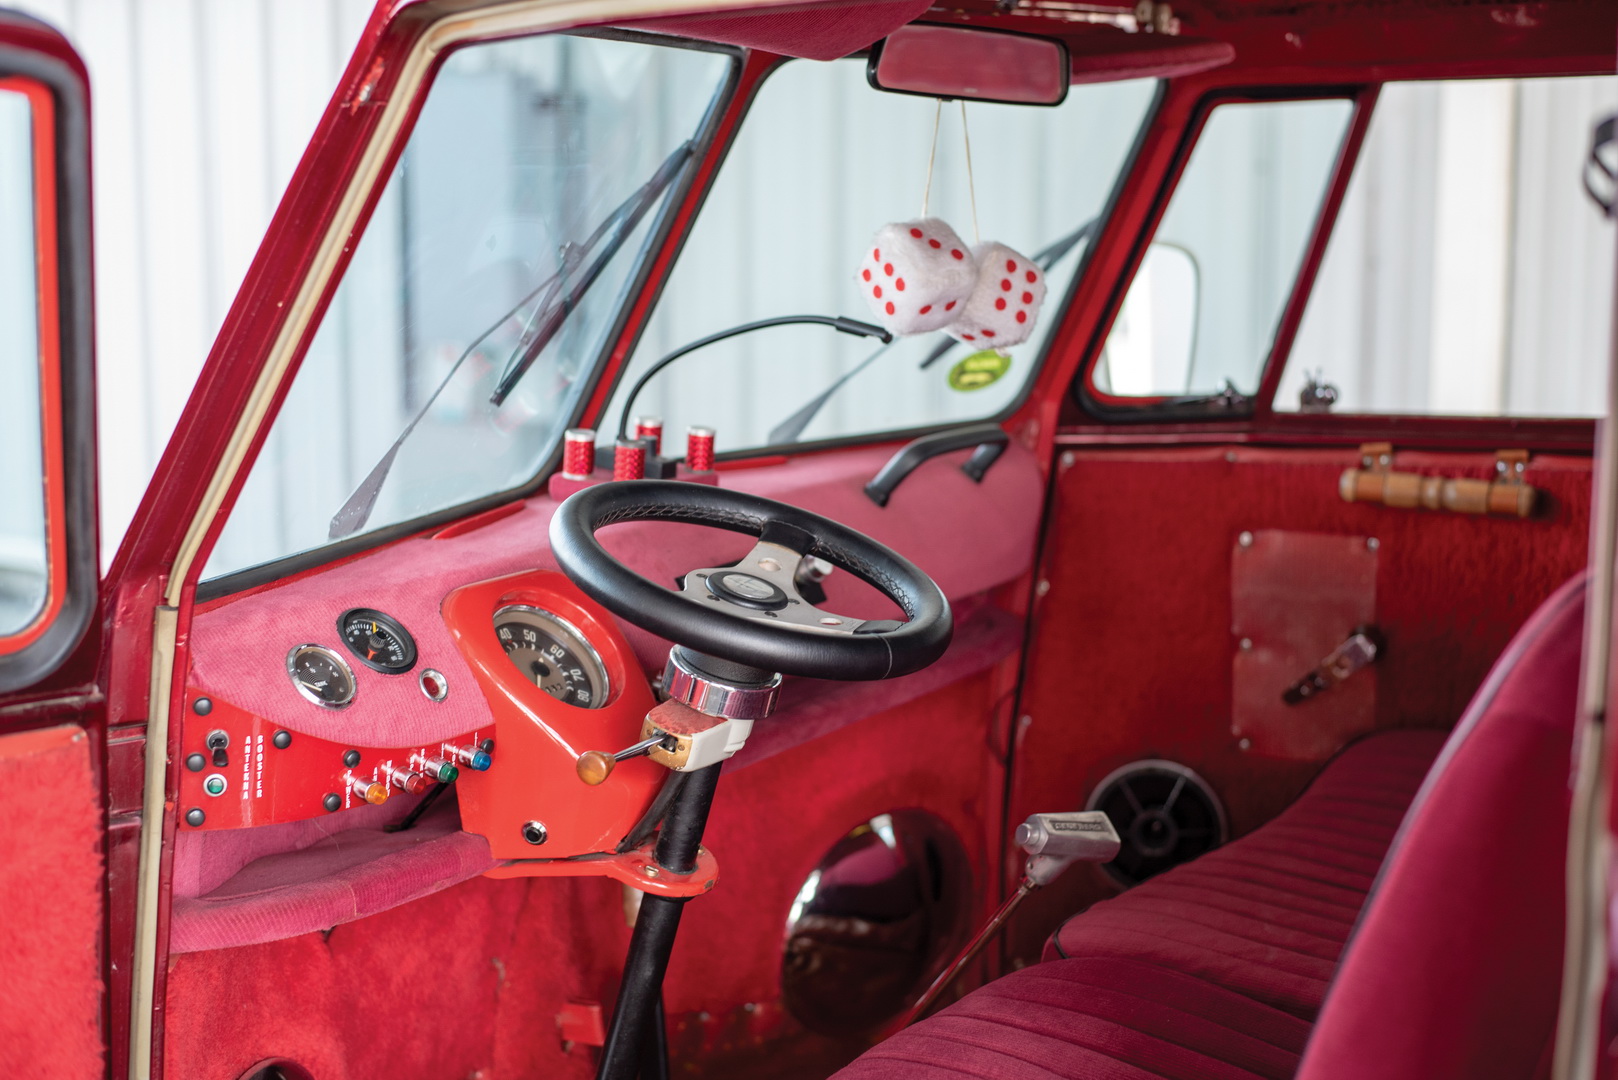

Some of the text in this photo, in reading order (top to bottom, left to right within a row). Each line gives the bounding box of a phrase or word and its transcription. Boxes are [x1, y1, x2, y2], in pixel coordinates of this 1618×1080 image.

[500, 627, 512, 640] 40
[523, 629, 536, 642] 50
[550, 644, 565, 659] 60
[570, 669, 584, 681] 70
[577, 689, 590, 703] 80
[256, 735, 264, 798] BOOSTER
